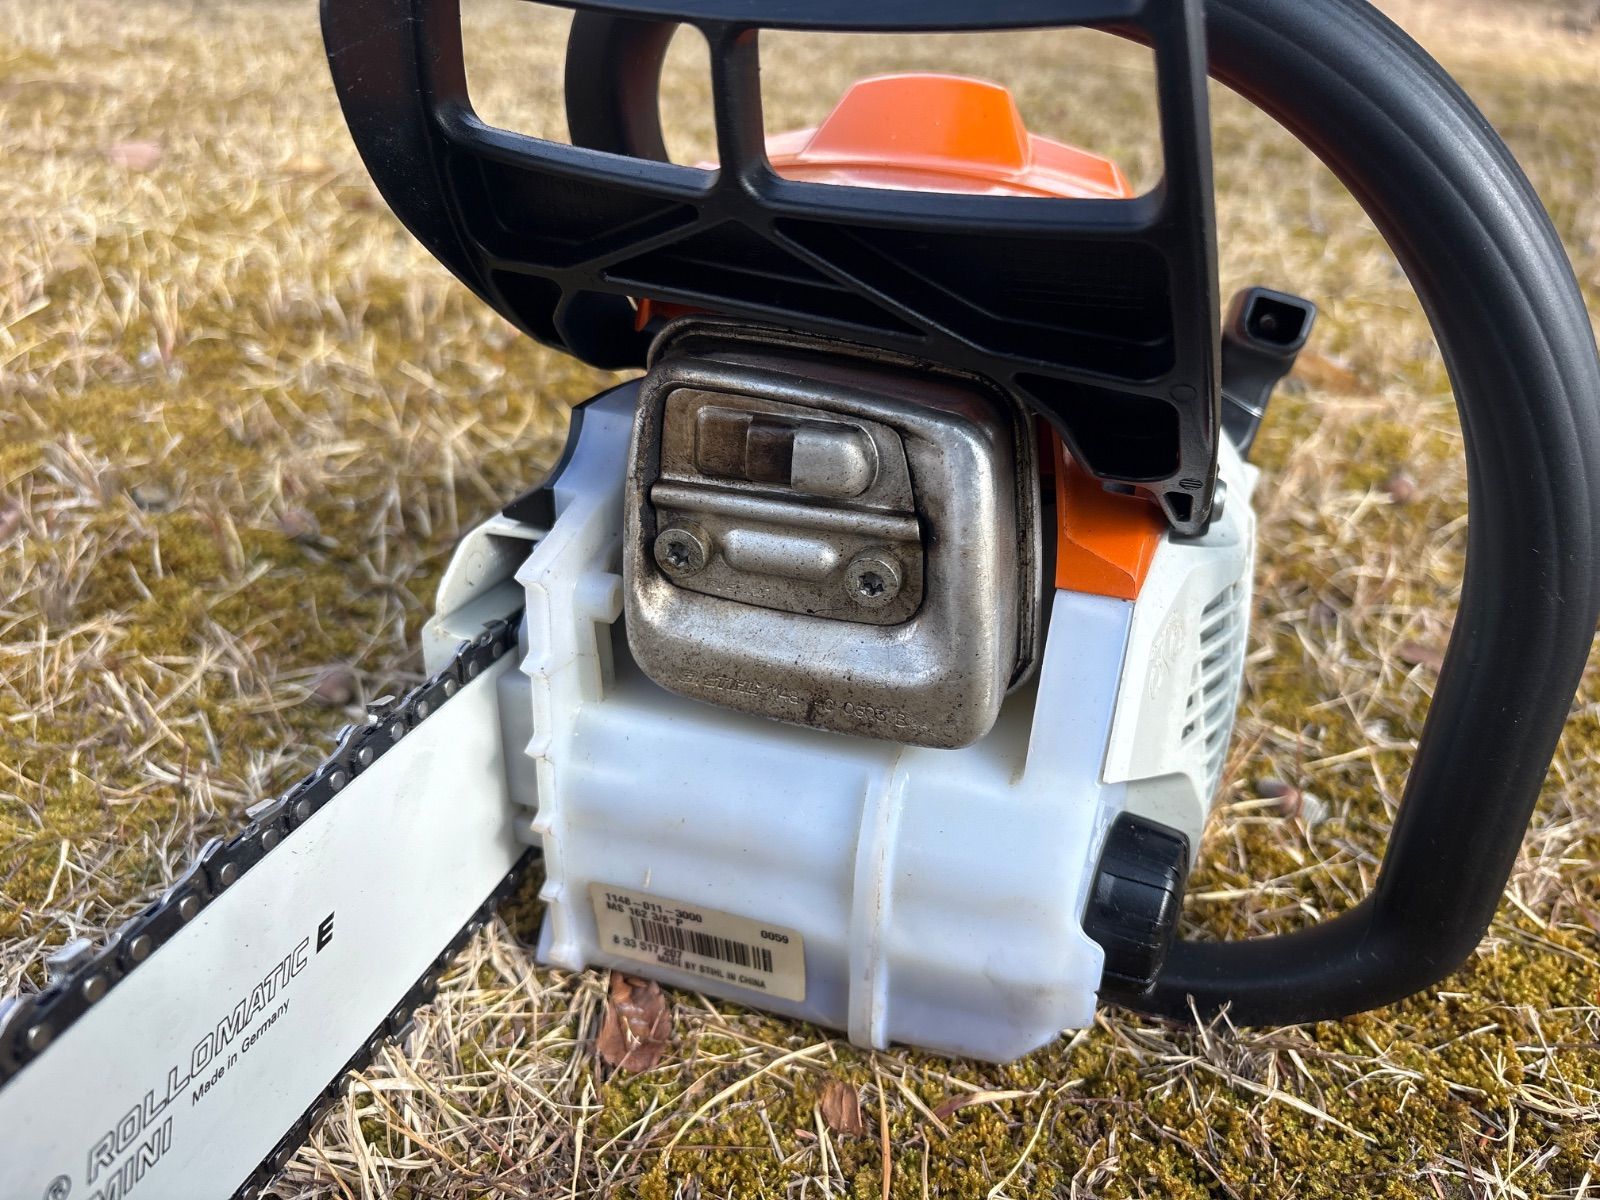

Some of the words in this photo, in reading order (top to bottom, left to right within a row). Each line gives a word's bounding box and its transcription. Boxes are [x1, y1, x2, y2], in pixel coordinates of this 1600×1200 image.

[606, 901, 625, 912] MS
[629, 907, 648, 918] 162
[760, 930, 790, 944] 0059
[684, 960, 696, 971] BY
[699, 964, 724, 978] STIHL
[726, 971, 737, 981] IN
[738, 974, 766, 987] CHINA
[87, 936, 310, 1186] ROLLOMATIC
[316, 911, 336, 954] E
[191, 1065, 226, 1107] Made
[226, 1052, 238, 1072] in
[241, 998, 291, 1054] Germany
